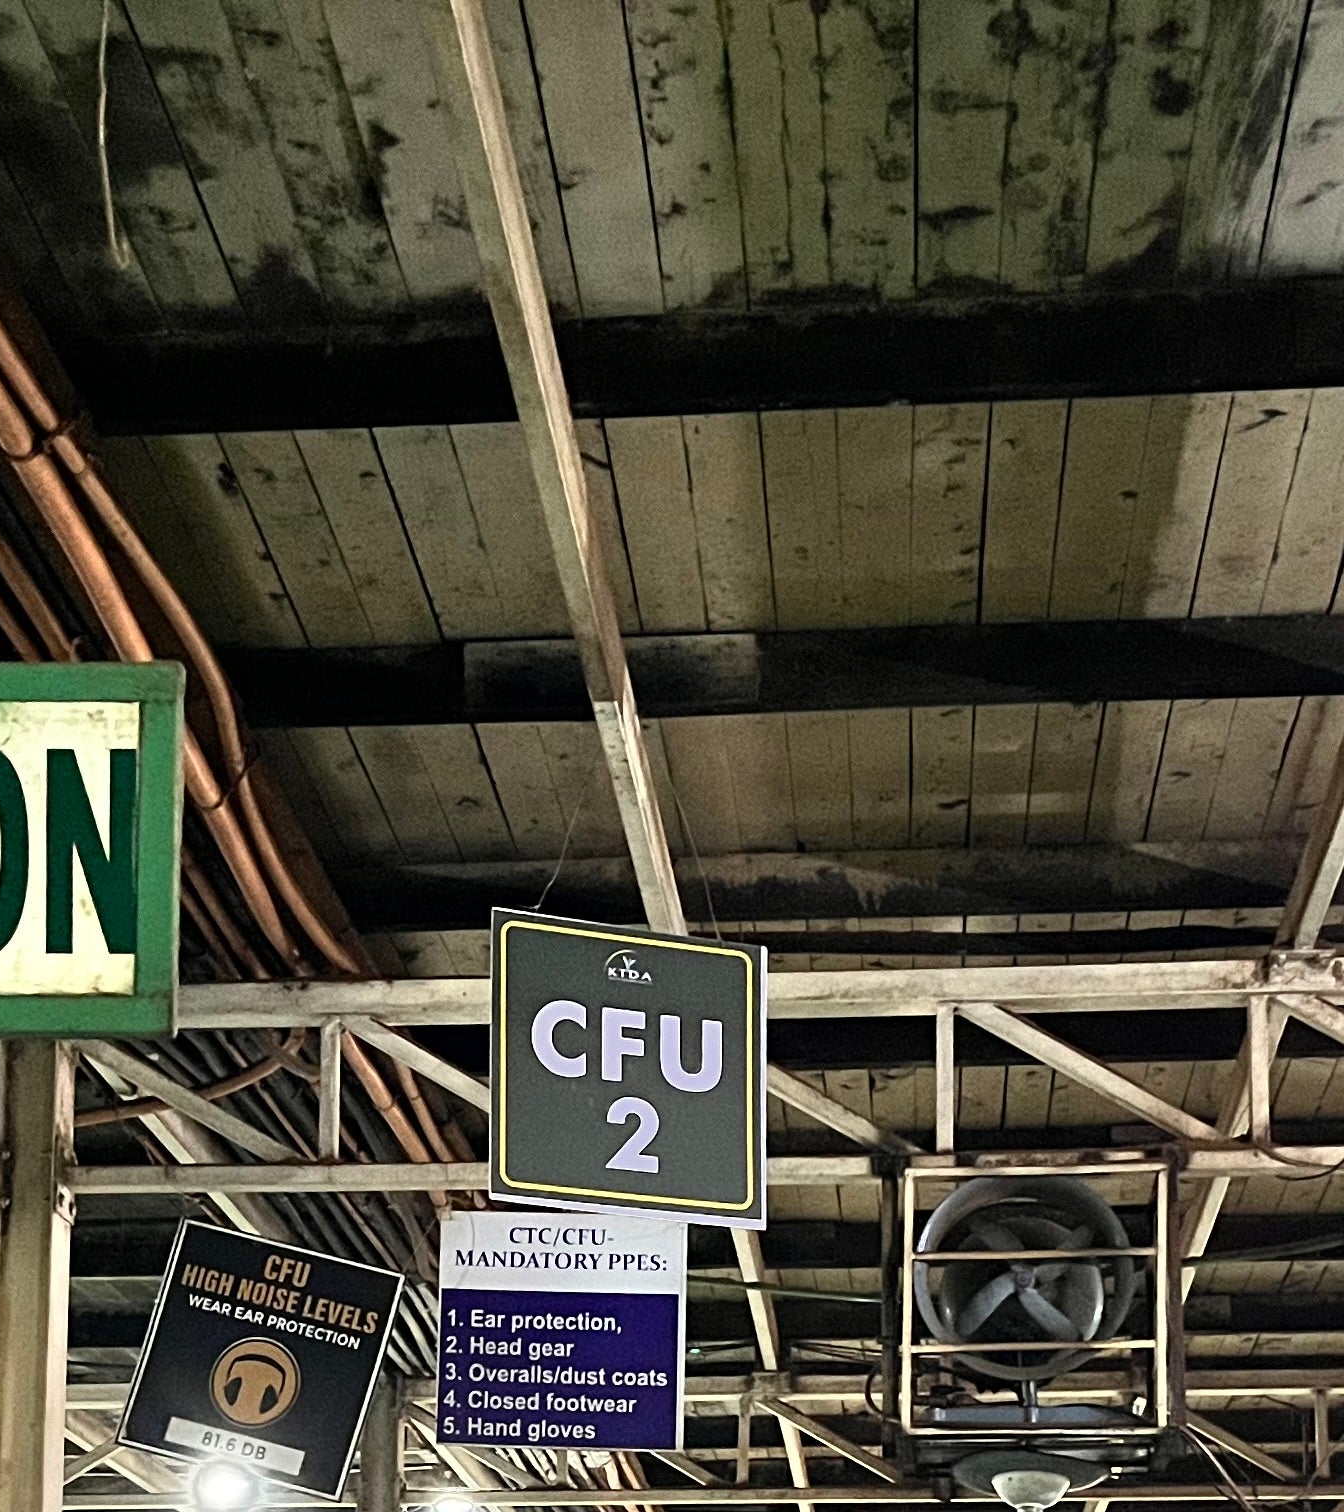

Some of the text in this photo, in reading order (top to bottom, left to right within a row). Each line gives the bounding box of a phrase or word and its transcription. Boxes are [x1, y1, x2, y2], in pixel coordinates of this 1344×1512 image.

[607, 966, 652, 982] KTDA
[531, 999, 723, 1093] CFU
[605, 1096, 660, 1174] 2
[509, 1226, 615, 1247] CTC/CFU-
[264, 1254, 311, 1288] CFU
[455, 1250, 668, 1272] MANDATORY PPES:
[181, 1264, 379, 1334] HIGH NOISE LEVELS
[188, 1293, 361, 1350] WEAR EAR PROTECTION
[447, 1308, 622, 1335] 1. Ear protection,
[445, 1336, 574, 1361] 2. Head gear
[445, 1363, 668, 1387] 3. Overalls/dust coats
[443, 1390, 637, 1413] 4. Closed footwear
[443, 1416, 596, 1442] 5. Hand gloves
[201, 1431, 267, 1461] 81.6 DB
